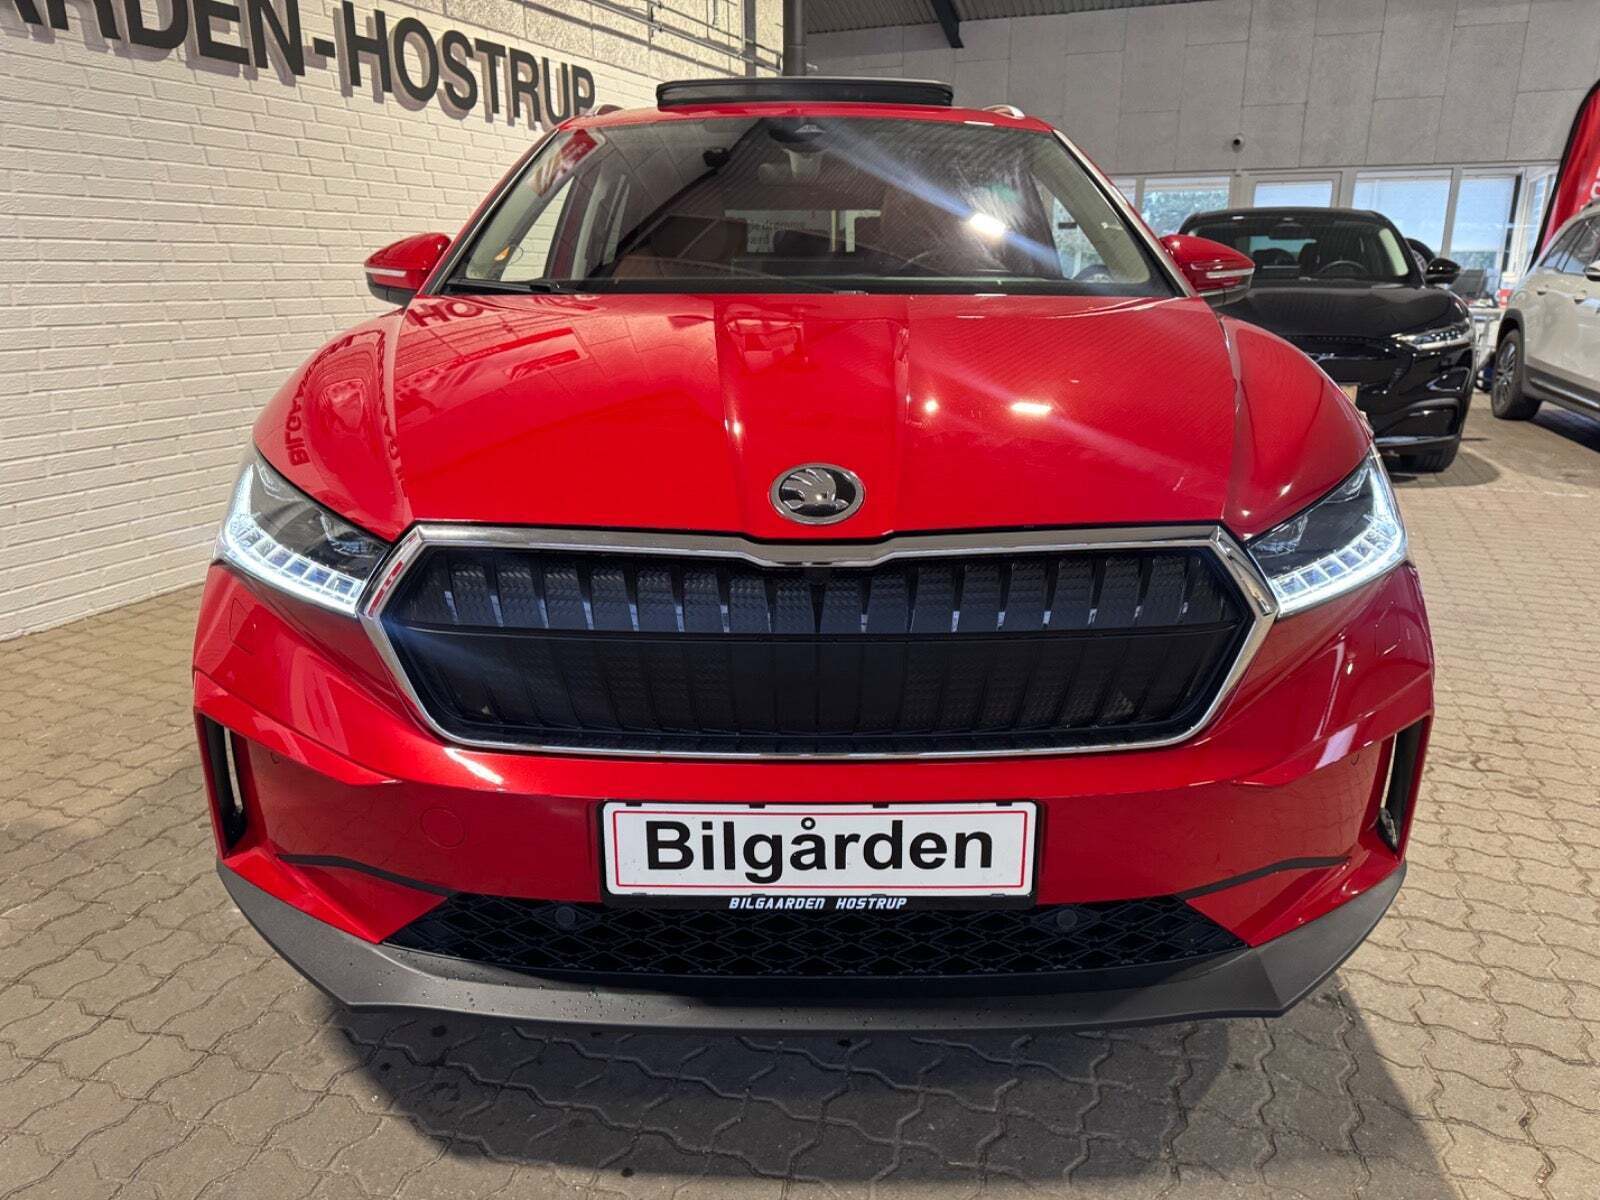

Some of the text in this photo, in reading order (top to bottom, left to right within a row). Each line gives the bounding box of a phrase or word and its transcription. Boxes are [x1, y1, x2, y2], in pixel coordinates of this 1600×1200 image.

[645, 817, 993, 883] Bilgården
[728, 897, 908, 910] BILGAARDEN HOSTRUP
